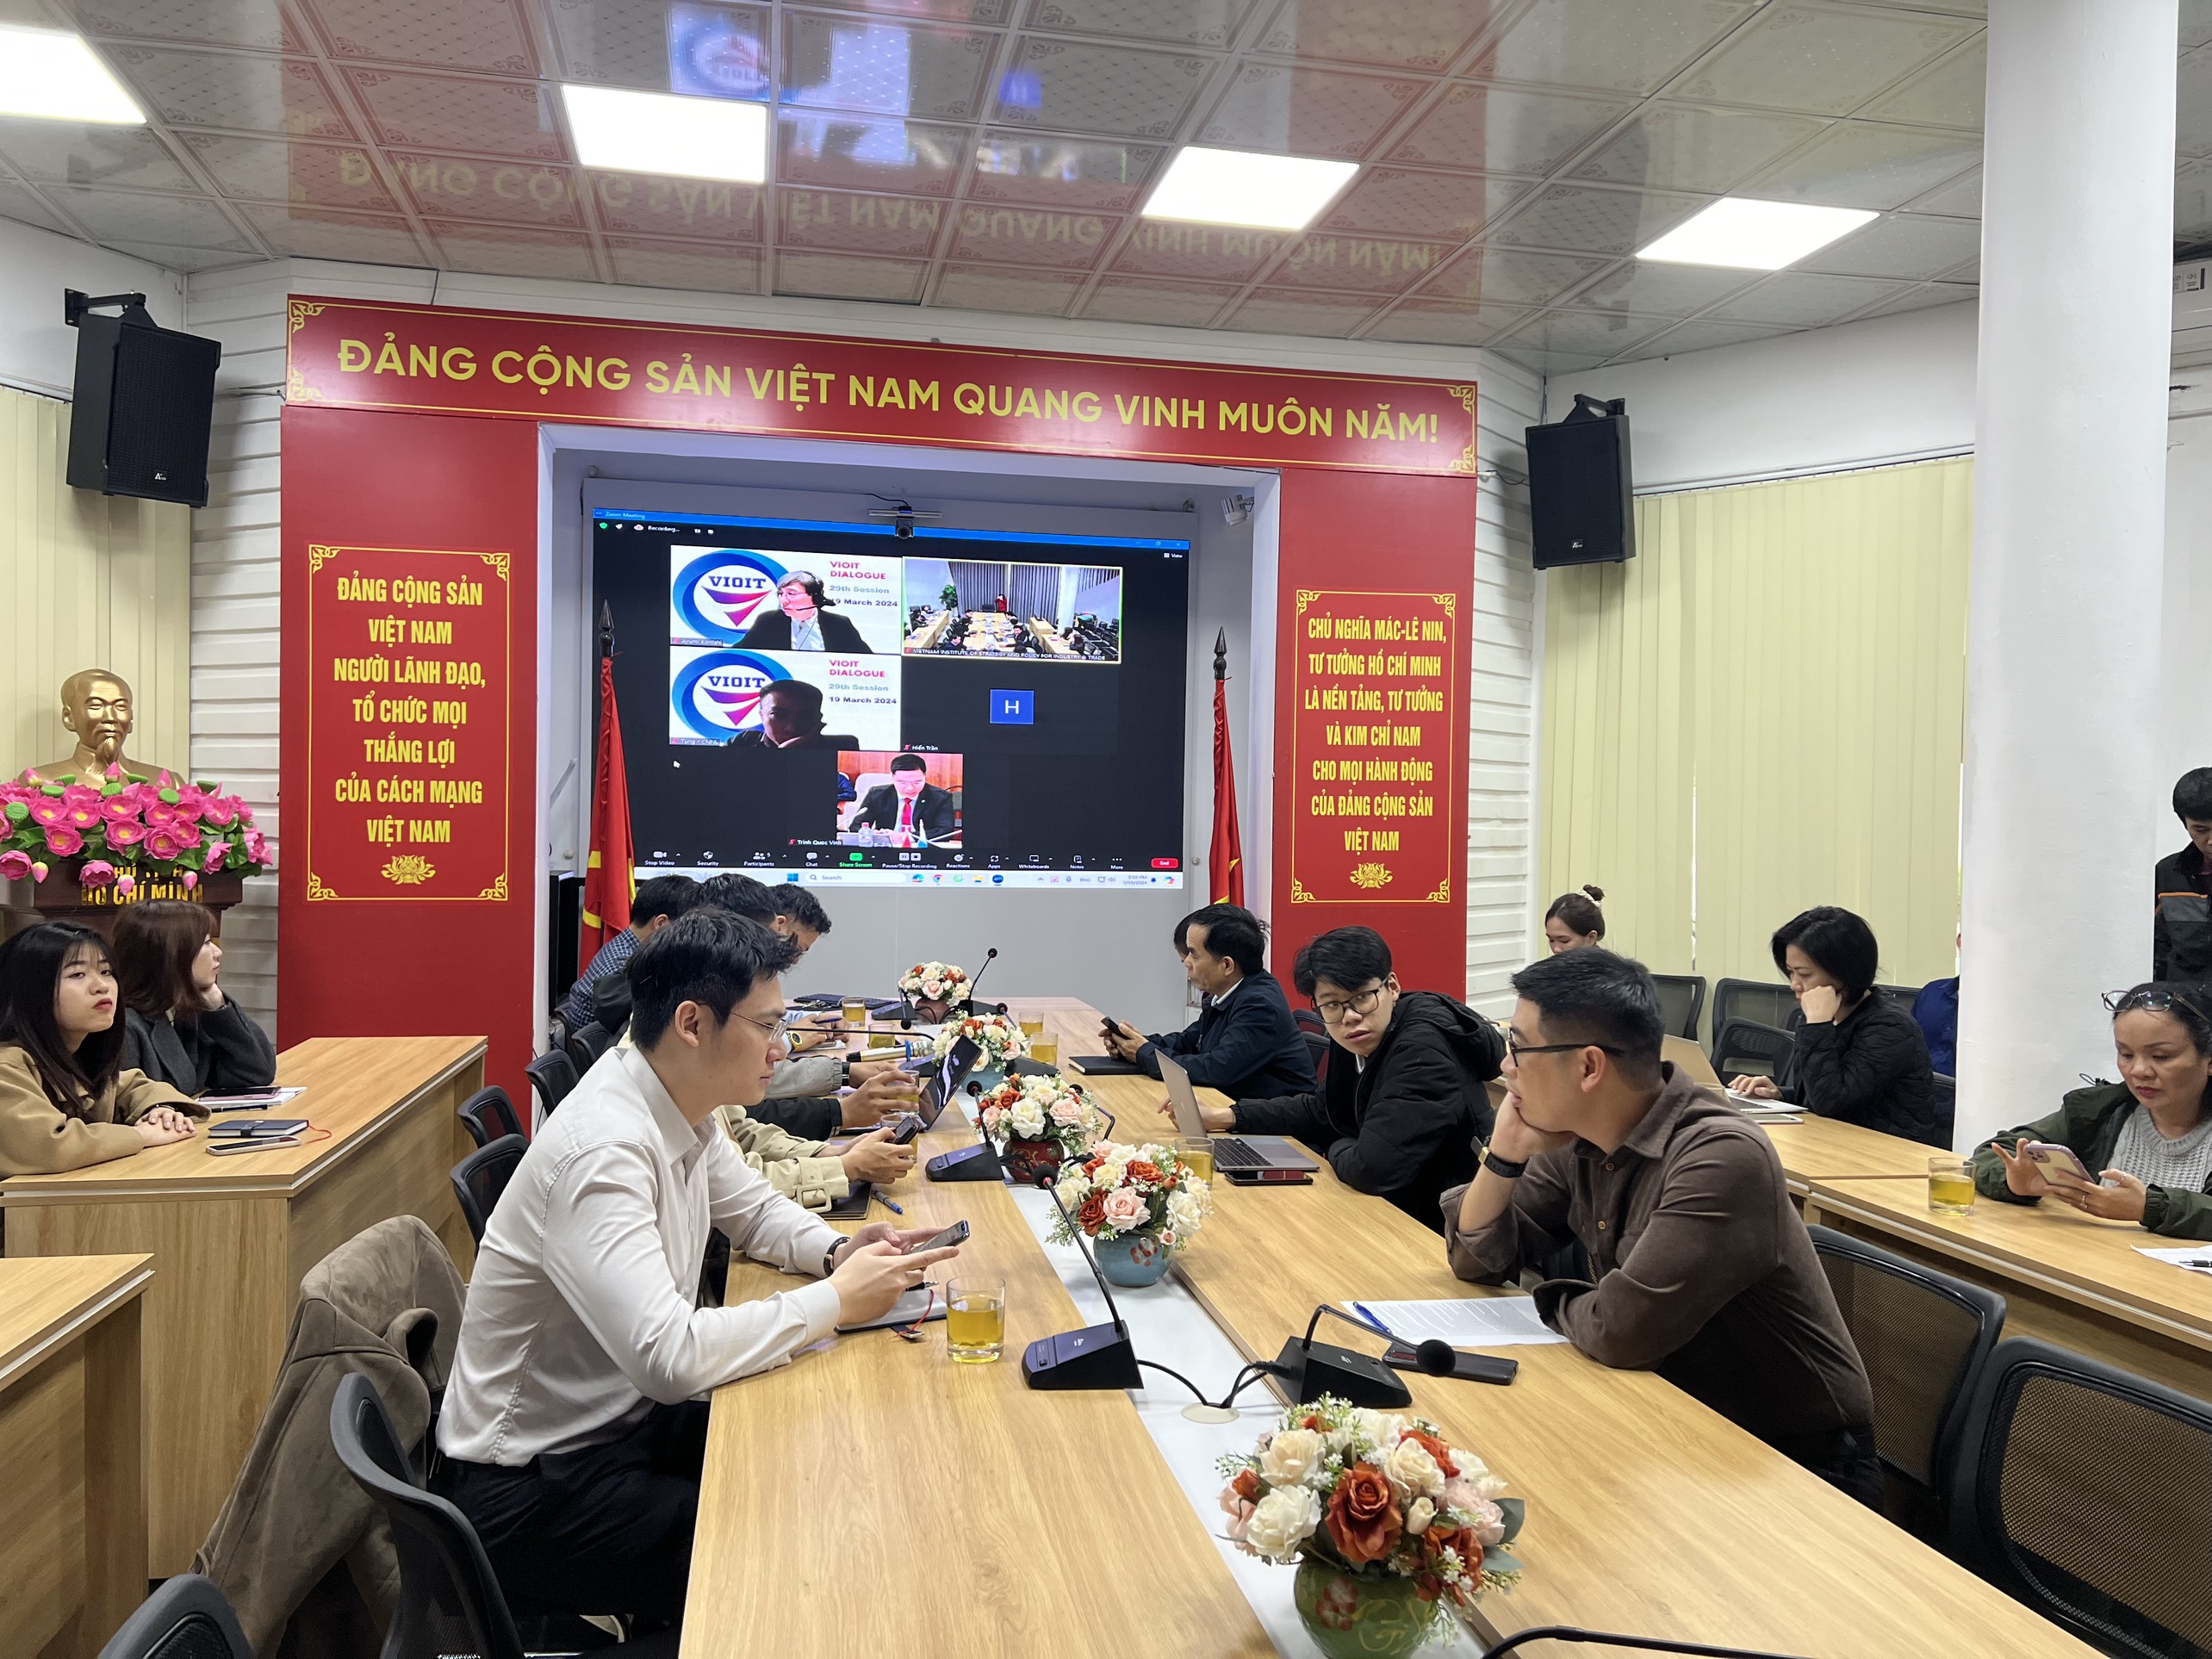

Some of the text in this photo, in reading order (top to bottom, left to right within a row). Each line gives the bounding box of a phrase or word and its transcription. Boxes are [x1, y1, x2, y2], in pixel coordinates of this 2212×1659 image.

[338, 332, 1438, 443] ĐẢNG CỘNG SẢN VIỆT NAM QUANG VINH MUÔN NĂM!
[337, 569, 482, 608] ĐẢNG CỘNG SẢN
[708, 575, 767, 588] VIOIT
[830, 570, 885, 580] DIALOGUE
[369, 615, 452, 648] VIỆT NAM
[1308, 611, 1447, 643] CHỦ NGHĨA MÁC-LÊ NIN,
[333, 655, 486, 689] NGƯỜI LÃNH ĐẠO,
[829, 668, 885, 677] DIALOGUE
[1308, 648, 1441, 677] TƯ TƯỞNG HỒ CHÍ MINH
[707, 675, 766, 688] VIOIT
[352, 690, 467, 729] TỔ CHỨC MỌI
[1004, 699, 1020, 715] H
[1305, 684, 1444, 713] LÀ NỀN TẢNG, TƯ TƯỞNG
[1327, 718, 1421, 747] VÀ KIM CHỈ NAM
[363, 730, 455, 768] THẮNG LỢI
[1313, 756, 1433, 786] CHO MỌI HÀNH ĐỘNG
[335, 771, 482, 808] CỦA CÁCH MẠNG
[1311, 788, 1433, 821] CỦA ĐẢNG CỘNG SẢN
[367, 815, 450, 848] VIỆT NAM
[1345, 827, 1400, 855] VIỆT NAM
